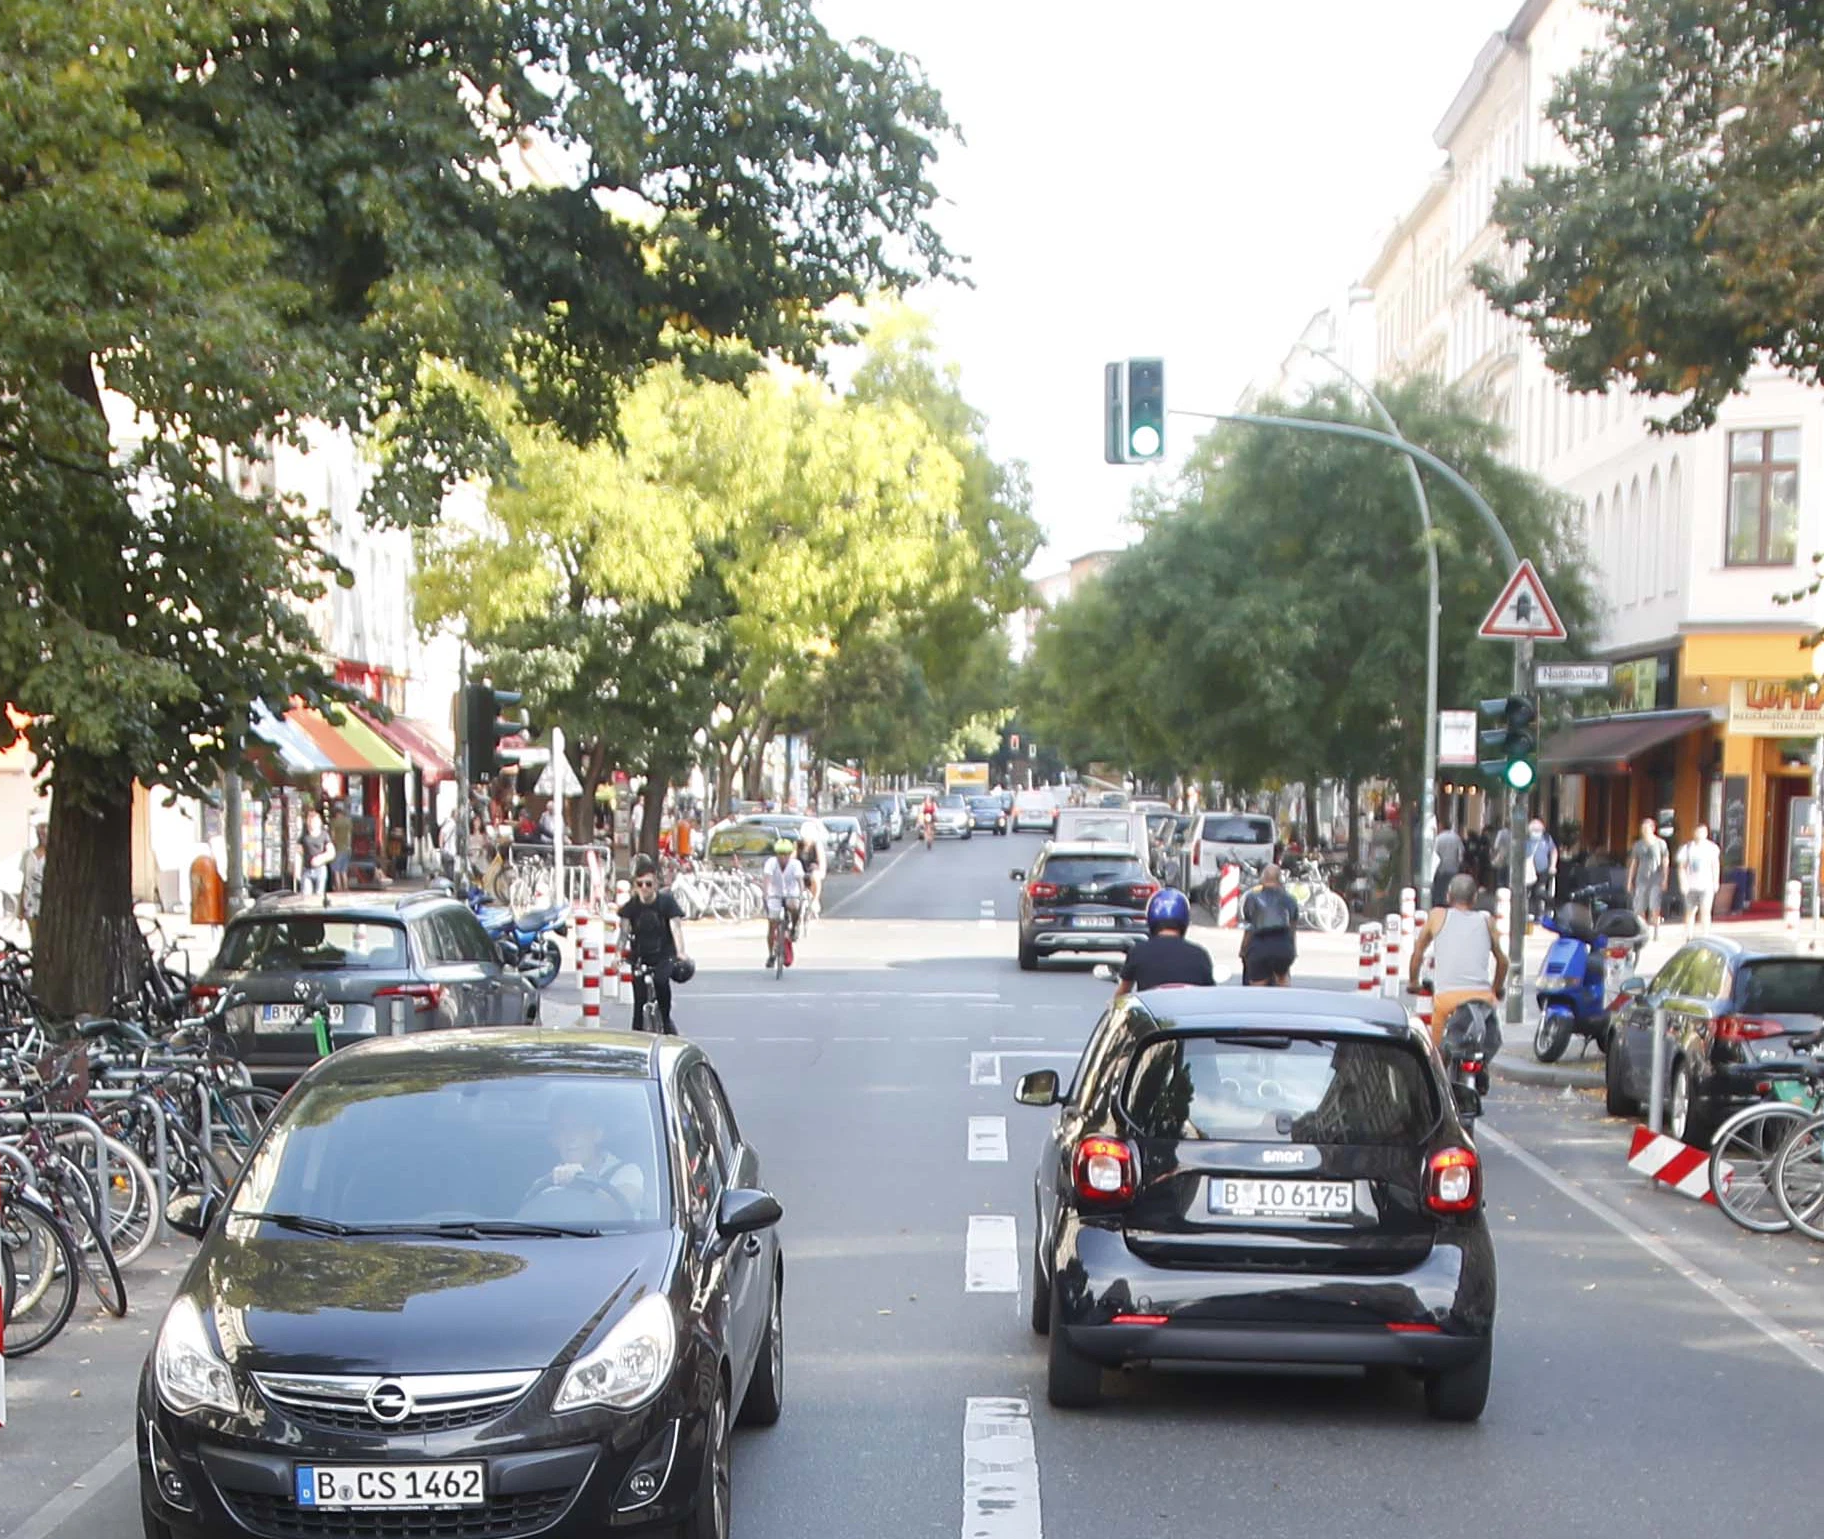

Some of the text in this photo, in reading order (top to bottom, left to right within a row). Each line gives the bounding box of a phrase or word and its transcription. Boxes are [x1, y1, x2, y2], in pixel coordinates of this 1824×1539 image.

[1262, 1150, 1304, 1164] smart
[1225, 1183, 1239, 1204] B
[1291, 1184, 1348, 1208] 6175
[318, 1470, 480, 1500] B CS 1462
